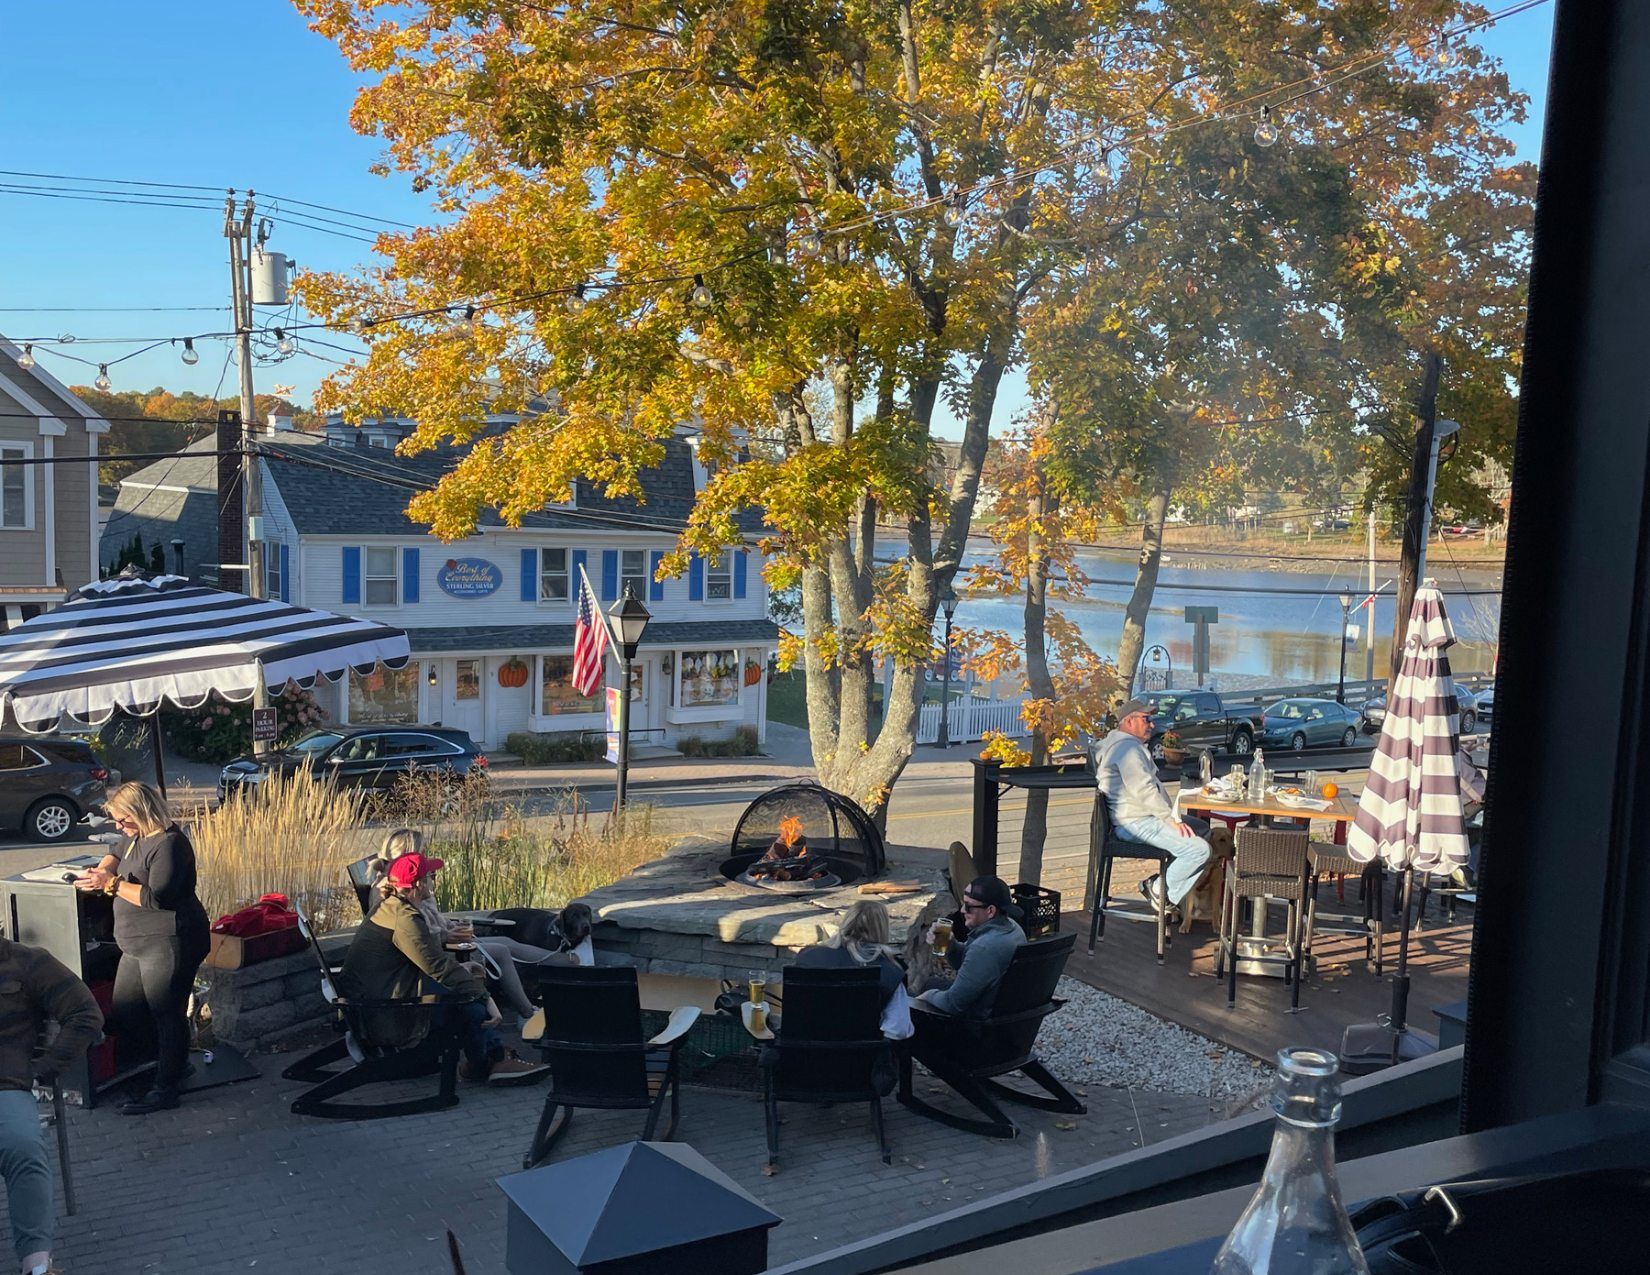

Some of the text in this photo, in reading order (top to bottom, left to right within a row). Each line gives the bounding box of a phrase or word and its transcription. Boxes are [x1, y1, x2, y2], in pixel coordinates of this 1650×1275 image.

[455, 563, 479, 574] Best
[445, 571, 493, 582] Everything
[262, 711, 268, 719] 2
